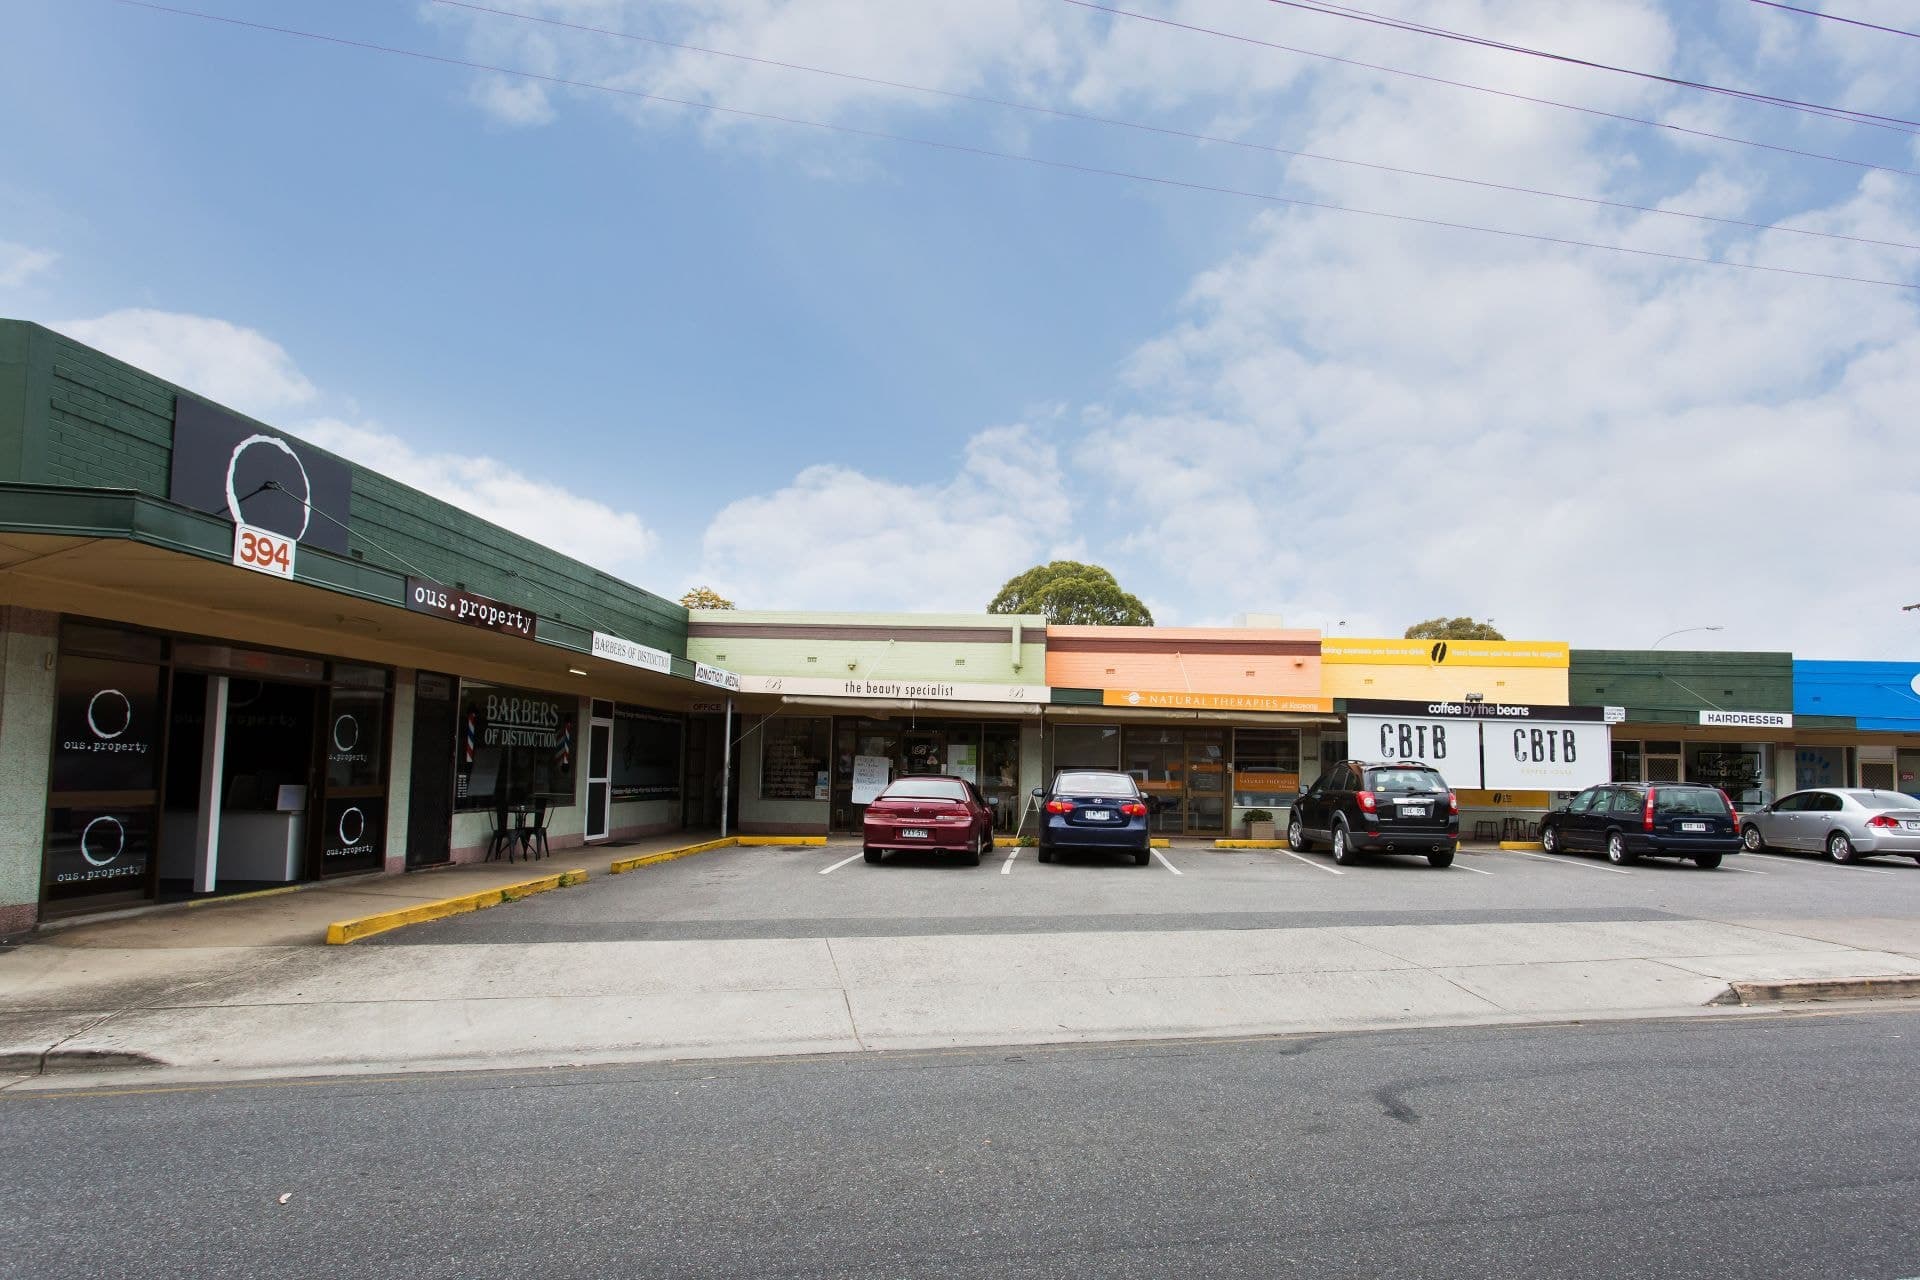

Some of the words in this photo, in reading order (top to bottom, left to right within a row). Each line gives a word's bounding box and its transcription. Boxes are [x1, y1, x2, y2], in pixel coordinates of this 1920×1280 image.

[240, 532, 290, 573] 394
[415, 587, 531, 634] ous.property
[594, 637, 626, 657] BARBERS
[628, 647, 637, 660] OF
[637, 650, 670, 672] DISTINCTION
[845, 681, 861, 693] the
[866, 681, 901, 697] beauty
[905, 683, 953, 698] specialist
[692, 703, 721, 711] OFFICE
[1149, 695, 1207, 706] NATURAL
[1213, 696, 1278, 708] THERAPIES
[1428, 702, 1462, 714] coffee
[1463, 703, 1476, 718] by
[1477, 703, 1496, 715] the
[1496, 703, 1530, 716] beans
[486, 694, 559, 727] BARBERS
[1707, 713, 1784, 725] HAIRDRESSER
[484, 728, 499, 746] OF
[501, 729, 557, 748] DISTINCTION
[1380, 723, 1447, 760] CBTB
[1513, 728, 1577, 763] CBTB
[64, 741, 148, 754] ous.property
[326, 844, 374, 856] ous.property
[57, 865, 141, 881] ous.property
